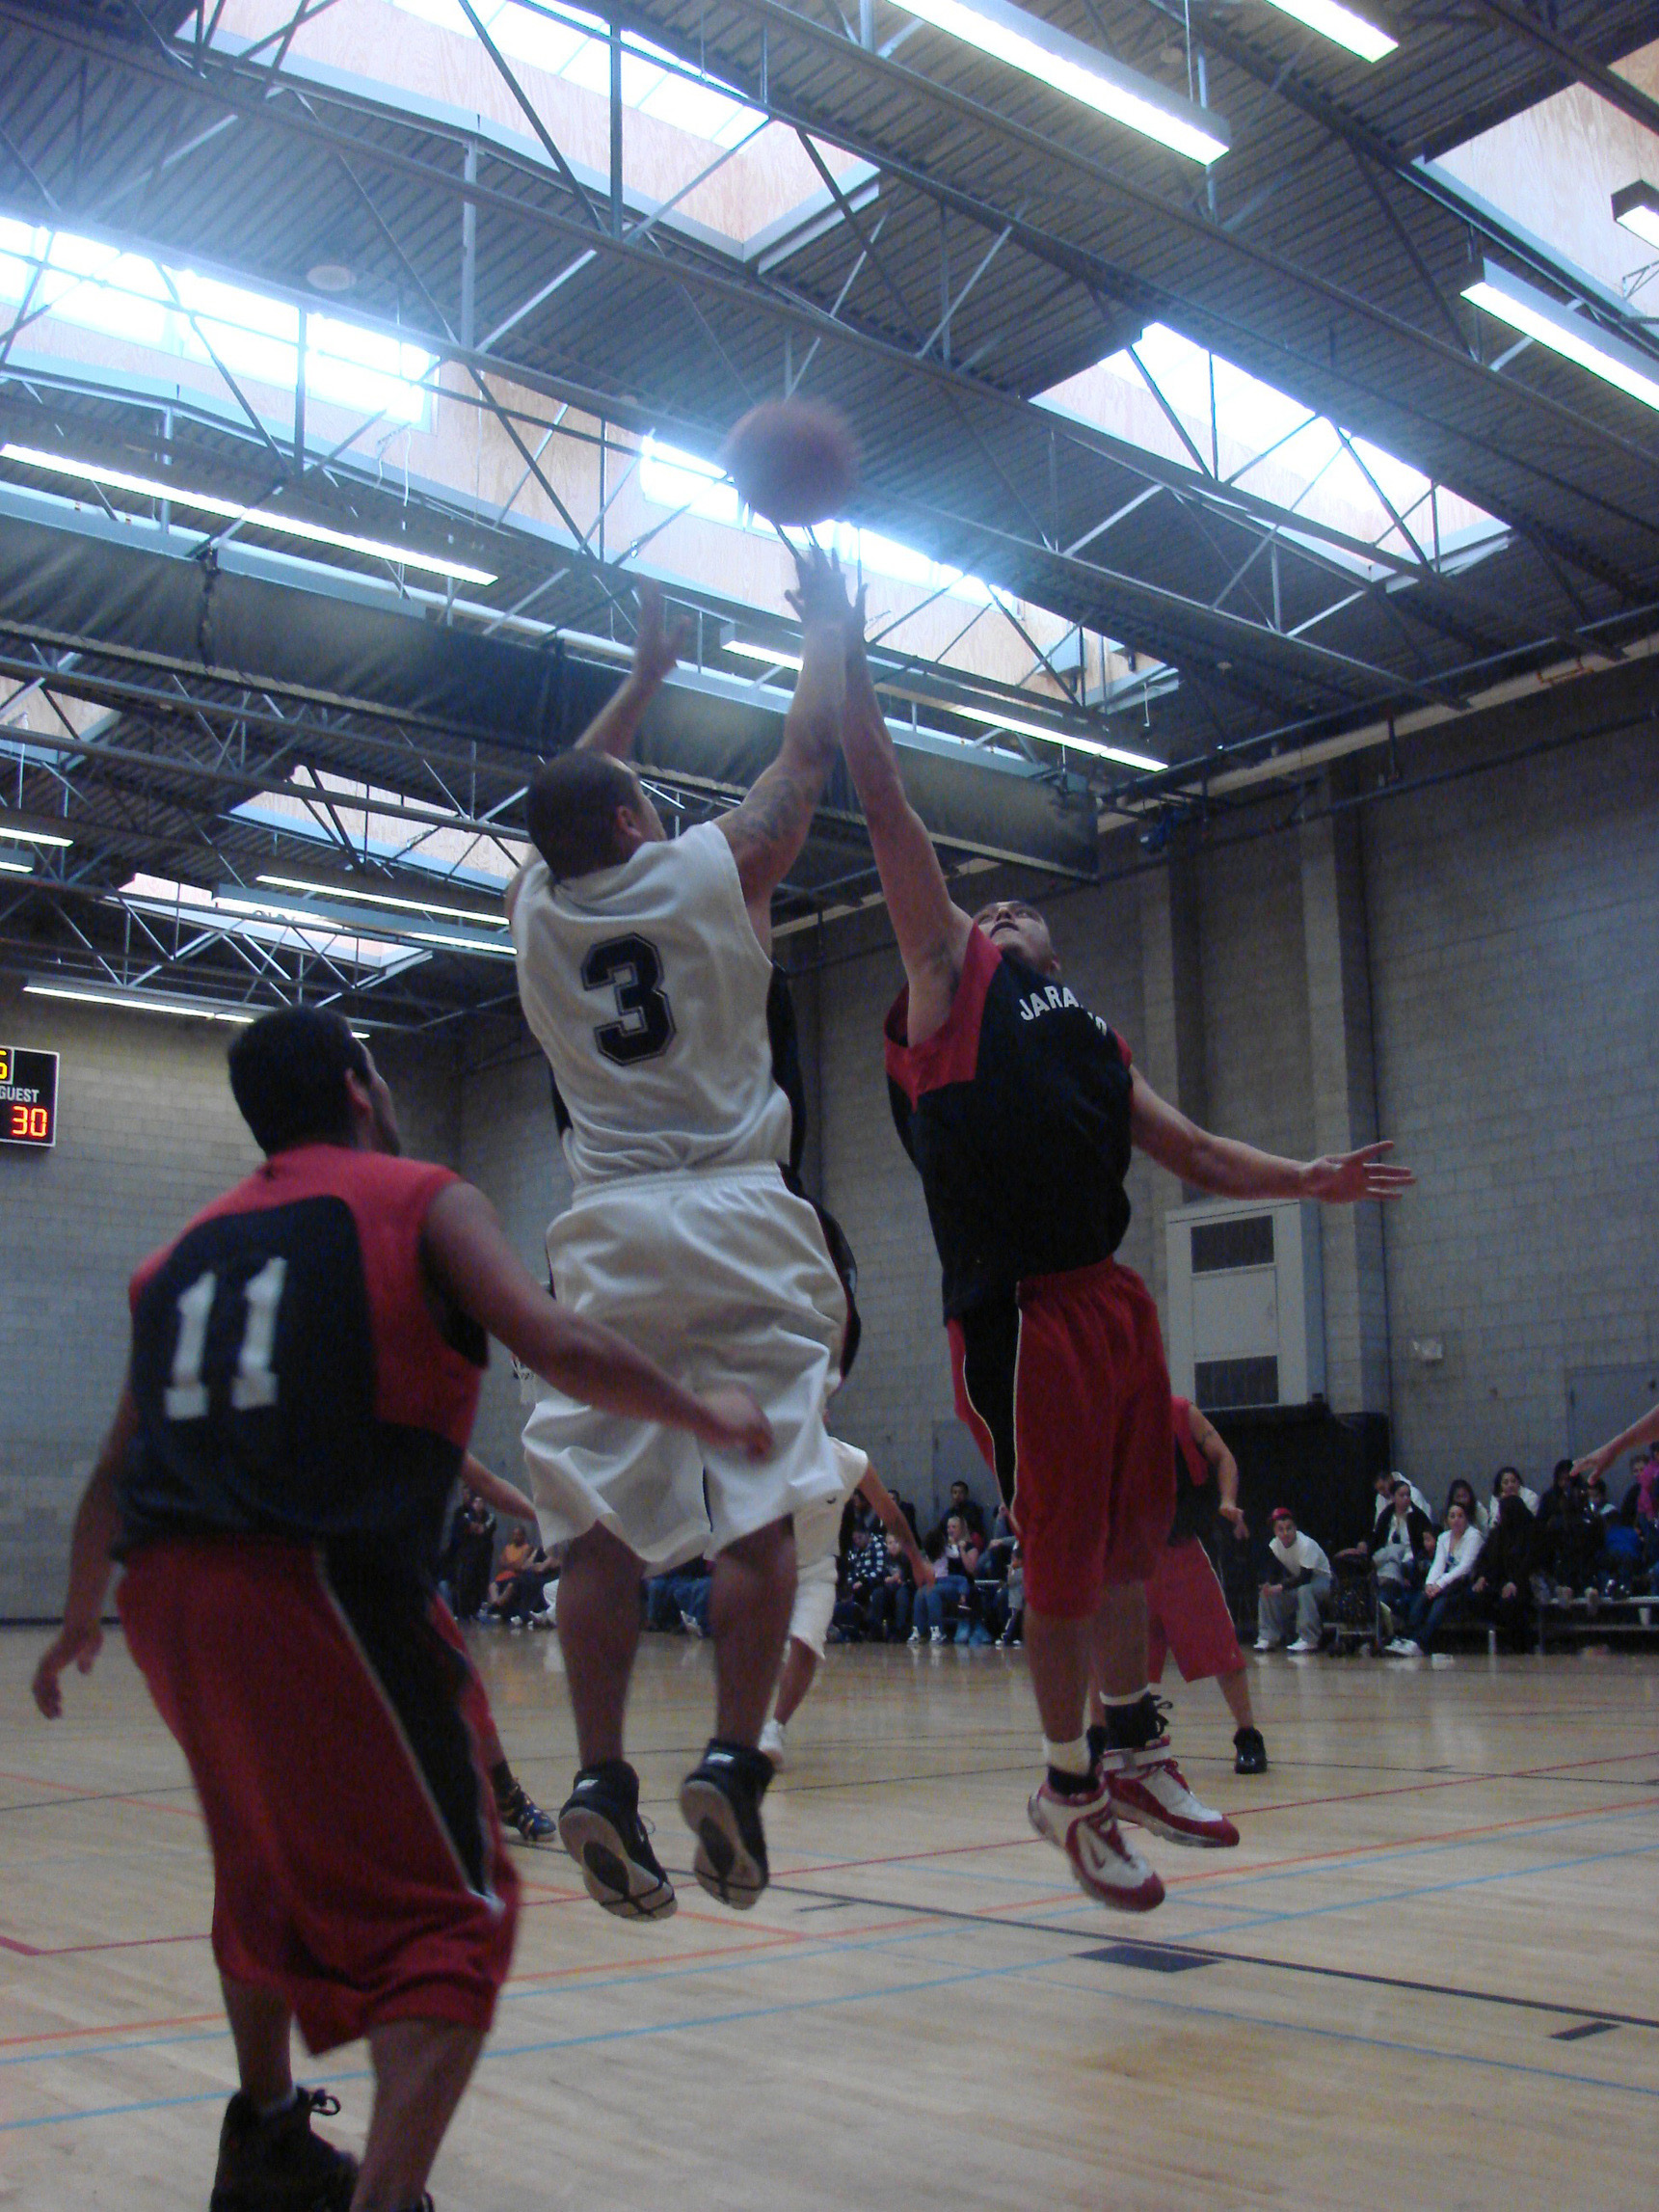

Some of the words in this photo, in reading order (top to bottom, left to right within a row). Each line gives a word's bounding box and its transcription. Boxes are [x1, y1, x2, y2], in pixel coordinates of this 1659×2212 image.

[580, 932, 677, 1067] 3
[0, 1085, 40, 1103] GUEST
[12, 1105, 48, 1138] 30
[163, 1256, 287, 1421] 11
